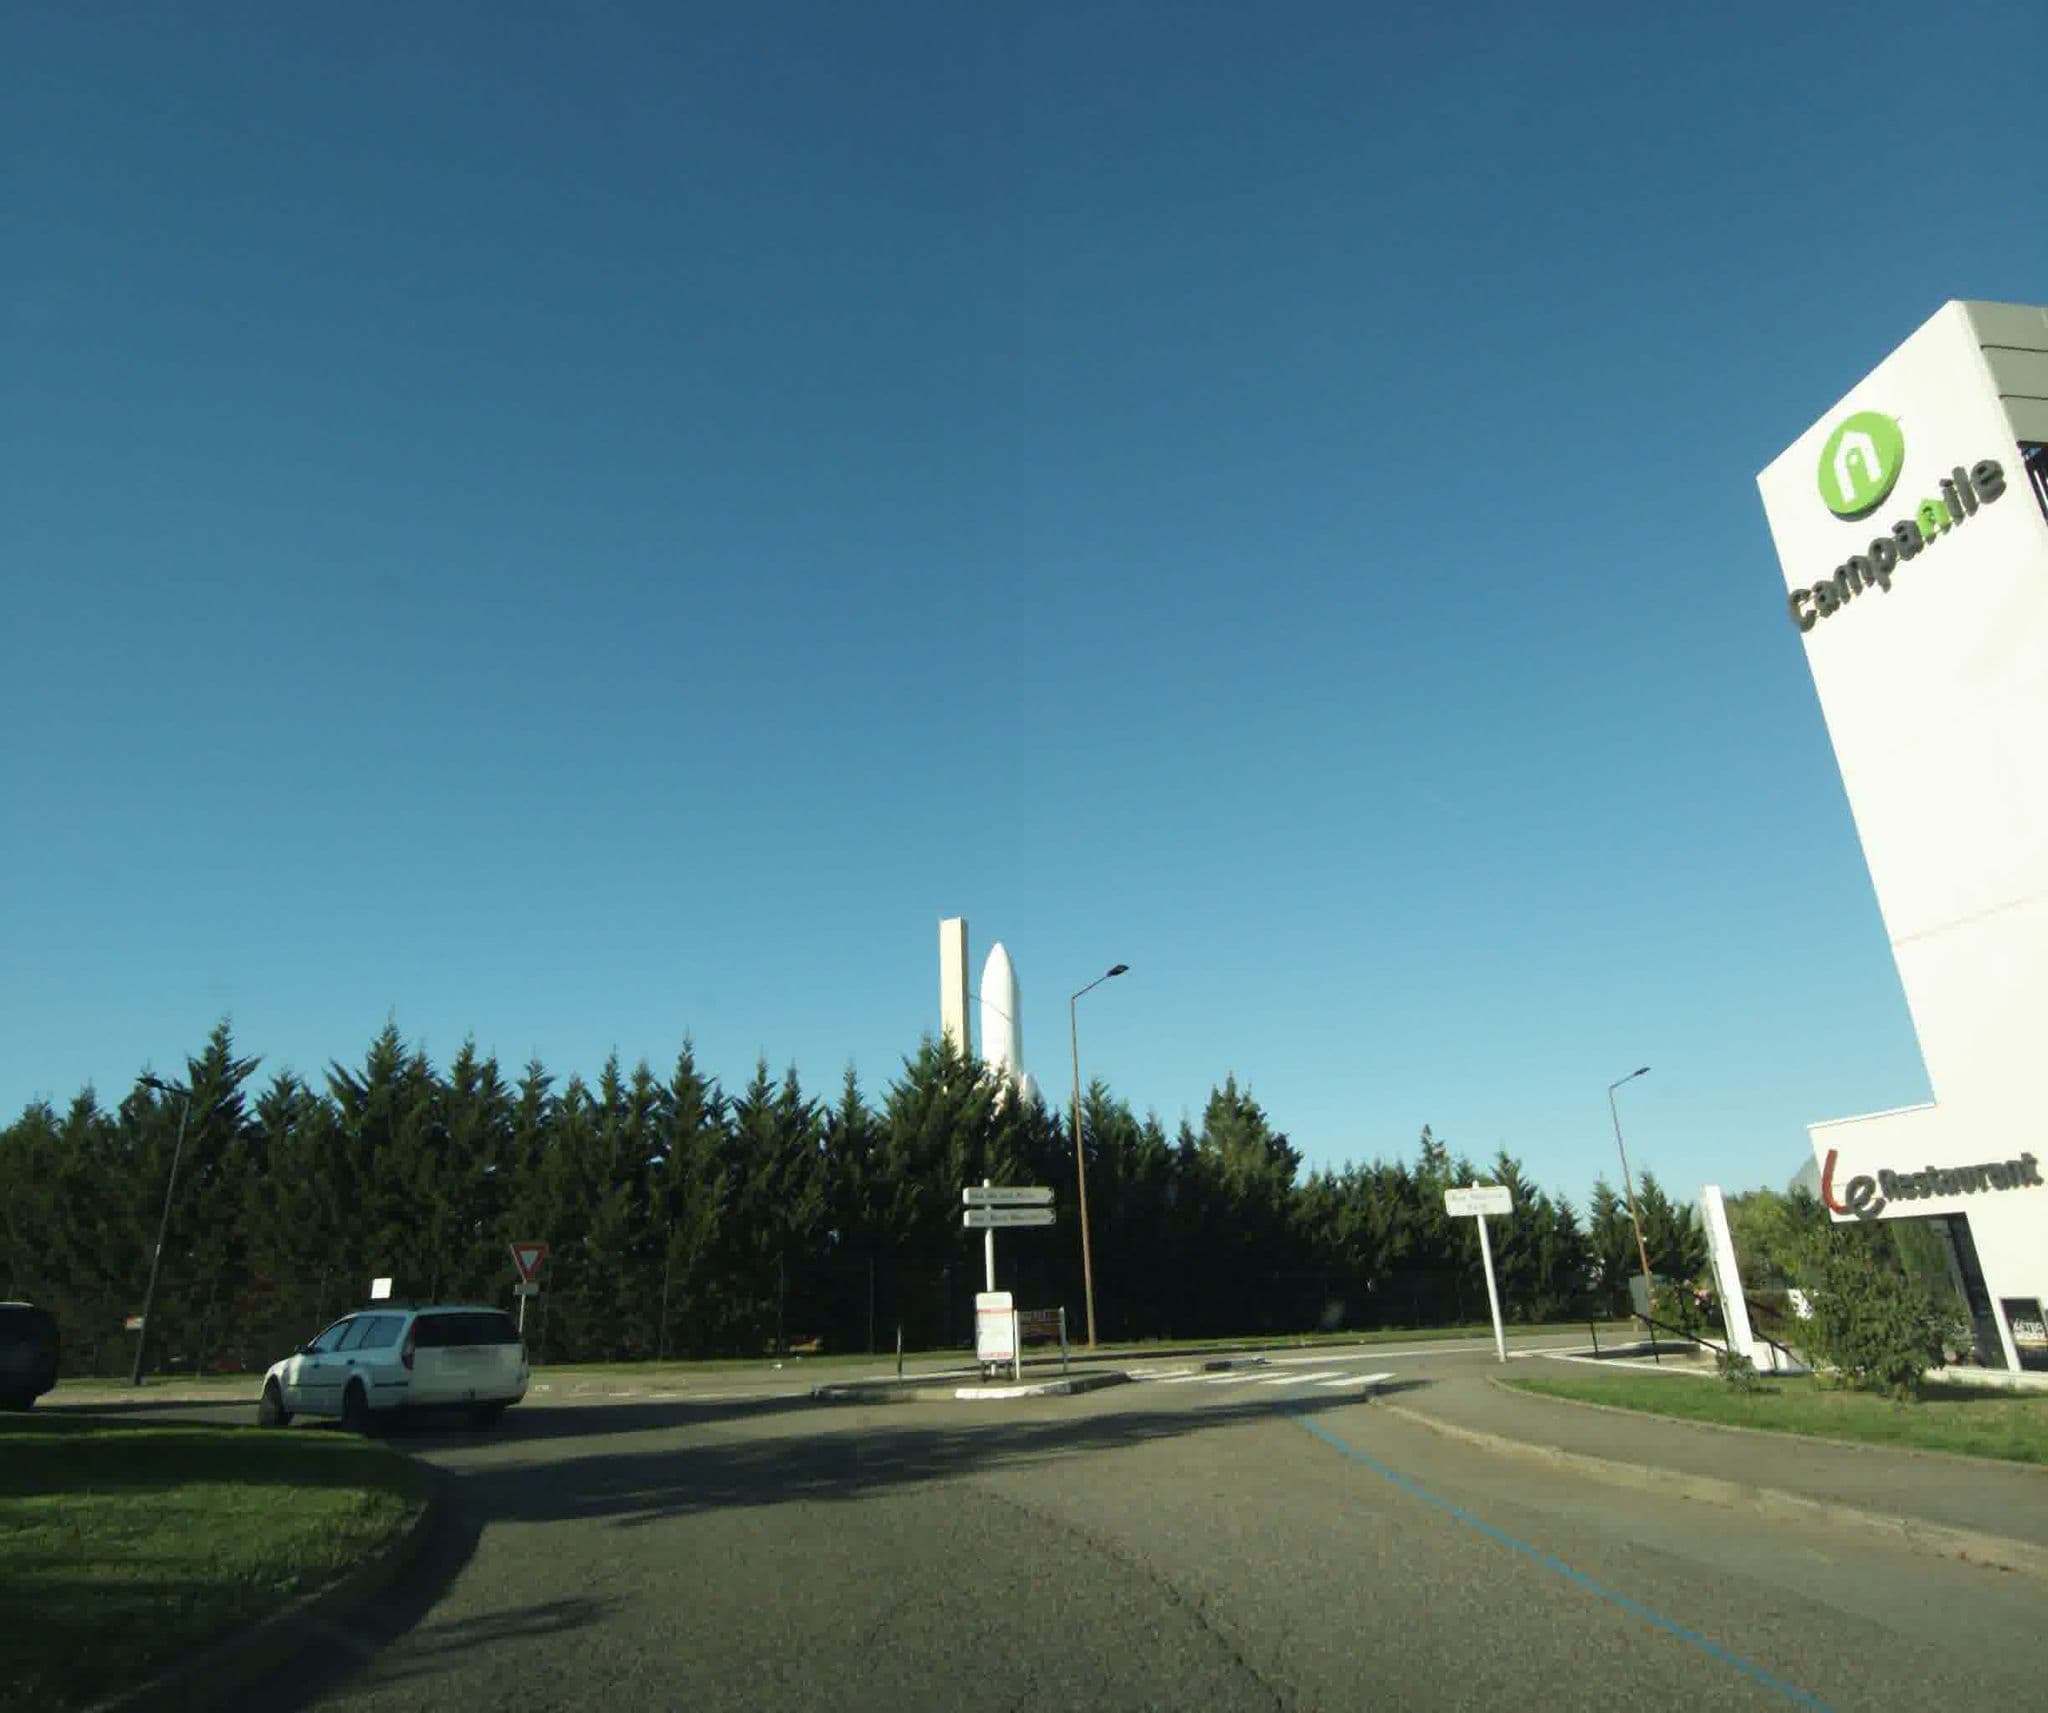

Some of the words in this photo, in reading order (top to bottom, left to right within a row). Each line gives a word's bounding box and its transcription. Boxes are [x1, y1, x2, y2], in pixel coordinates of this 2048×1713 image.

[1789, 459, 2006, 632] campanile
[1822, 1149, 1886, 1219] Le
[1878, 1152, 2044, 1201] Restaurant
